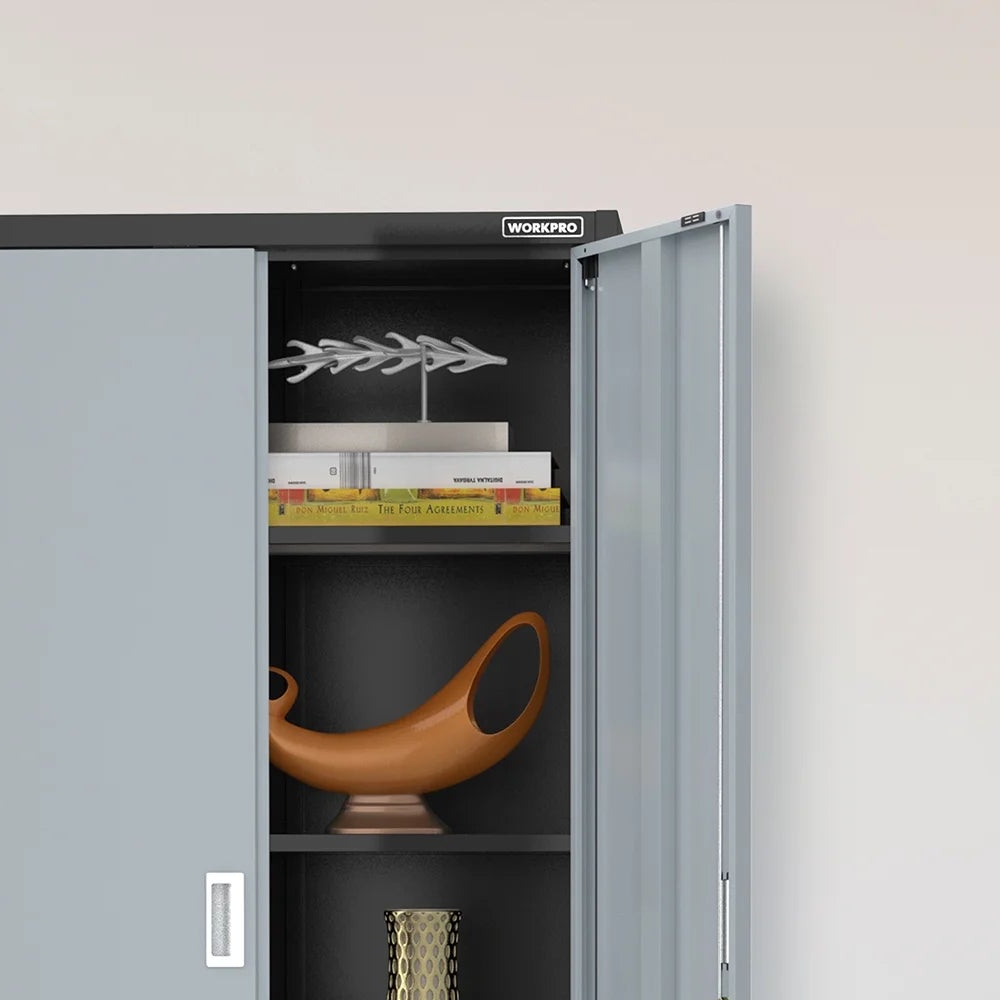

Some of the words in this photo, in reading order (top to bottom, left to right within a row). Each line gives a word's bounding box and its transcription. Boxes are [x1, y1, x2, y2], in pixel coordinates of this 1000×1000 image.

[507, 222, 578, 234] WORKPRO
[296, 506, 313, 514] DON
[316, 505, 346, 514] MIGUEL
[350, 505, 368, 514] RUIZ
[378, 504, 394, 514] THE
[399, 504, 422, 514] FOUR
[426, 504, 484, 514] AGREEMENTS
[512, 505, 529, 513] DON
